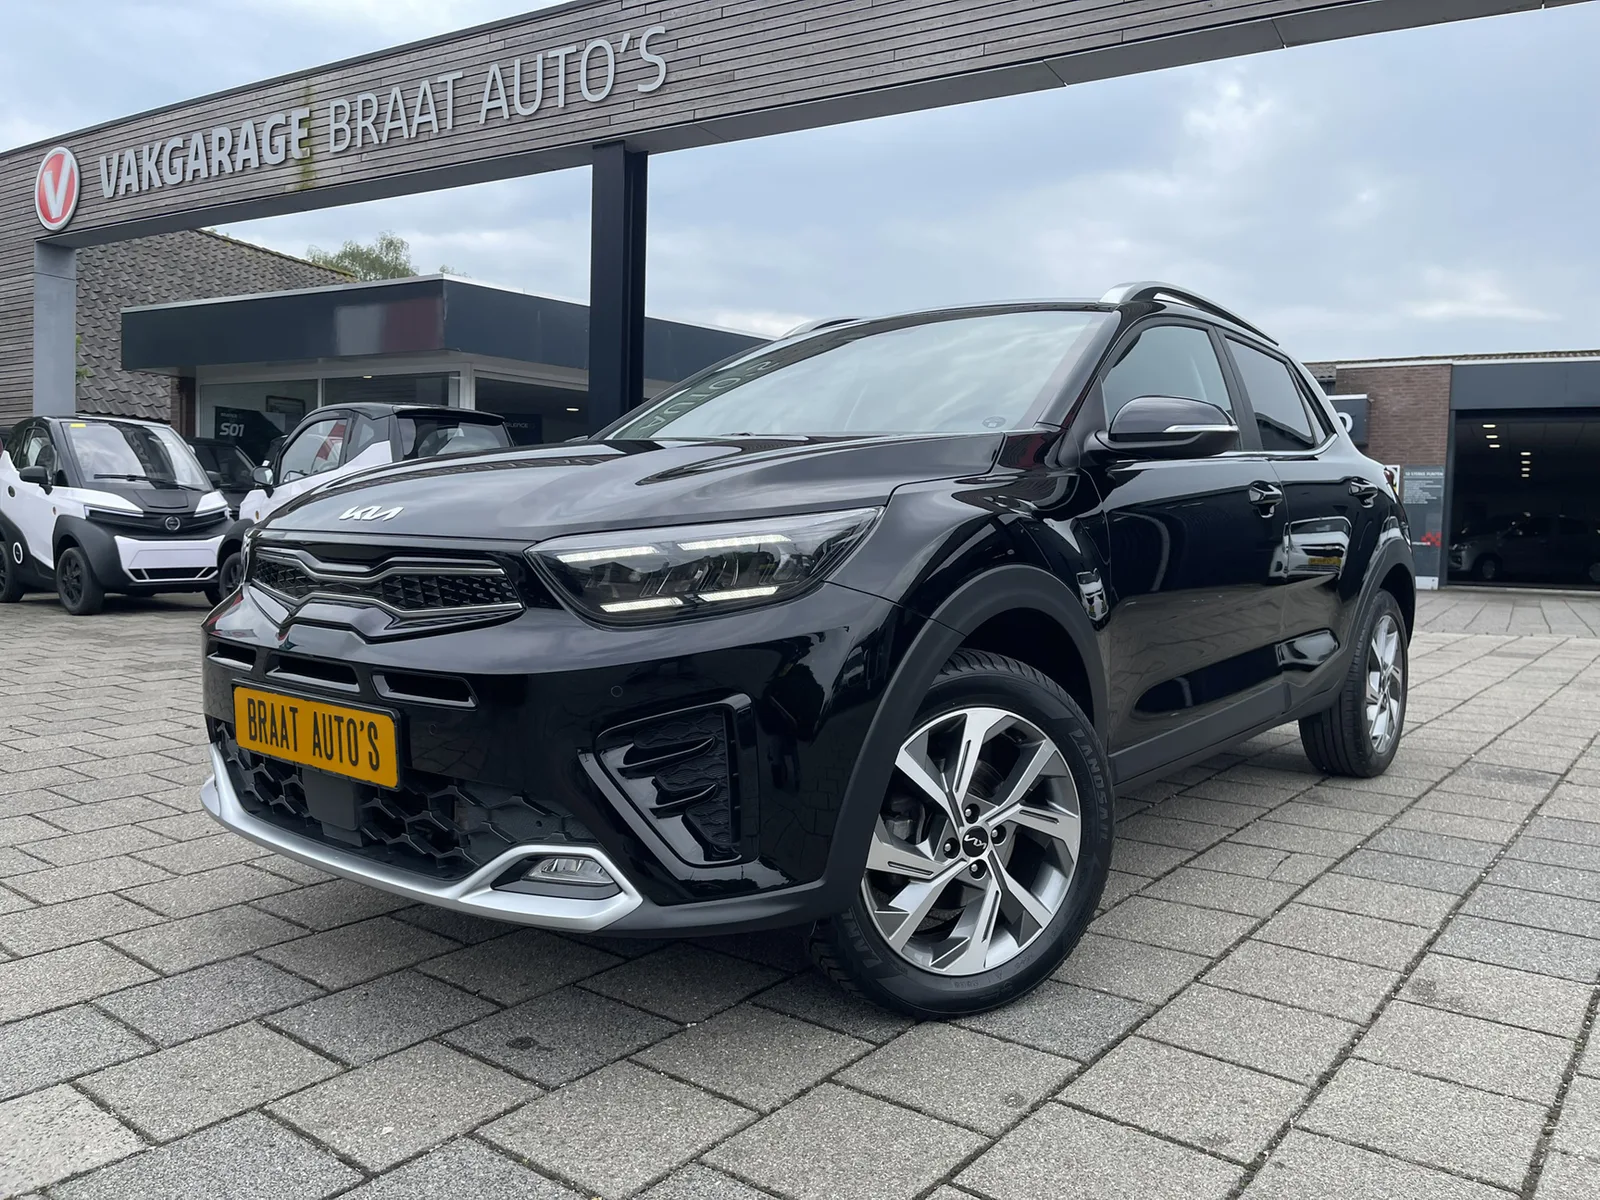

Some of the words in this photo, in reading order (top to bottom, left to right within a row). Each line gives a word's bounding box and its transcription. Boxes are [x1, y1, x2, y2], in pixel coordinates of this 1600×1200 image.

[99, 107, 311, 199] VAKGARAGE
[329, 71, 464, 153] BRAAT
[479, 25, 667, 125] AUTO'S
[43, 154, 75, 220] V
[219, 422, 245, 437] S01
[338, 505, 405, 522] KIA
[247, 697, 299, 752] BRAAT
[312, 710, 381, 772] AUTO'S
